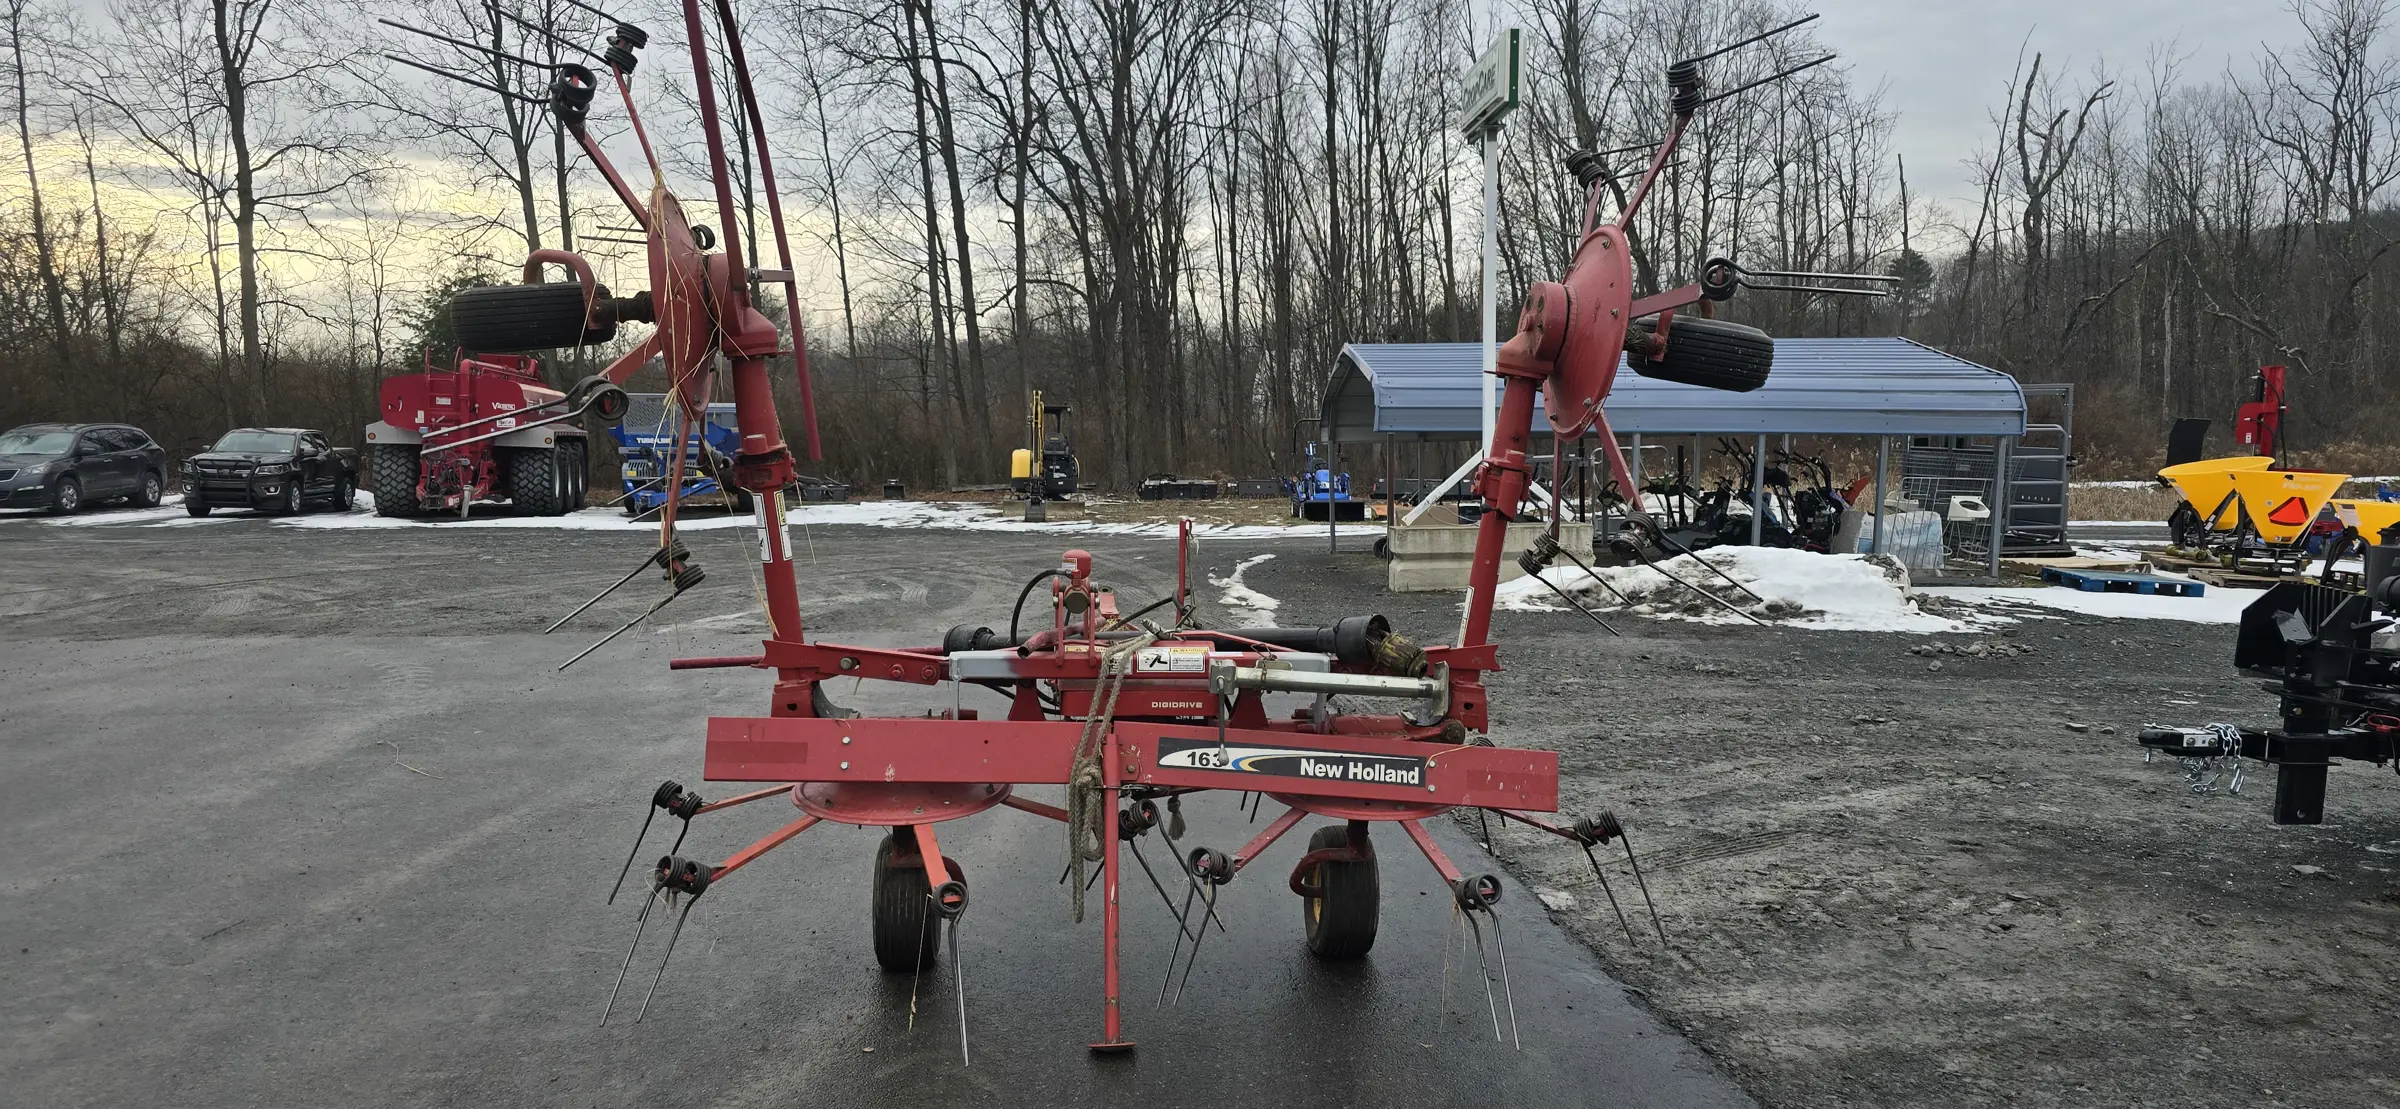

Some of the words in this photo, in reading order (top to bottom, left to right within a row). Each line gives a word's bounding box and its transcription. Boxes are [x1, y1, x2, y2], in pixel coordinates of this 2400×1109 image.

[1151, 701, 1203, 709] DIGIDRIVE
[1300, 758, 1343, 778] New
[1349, 761, 1419, 784] Holland
